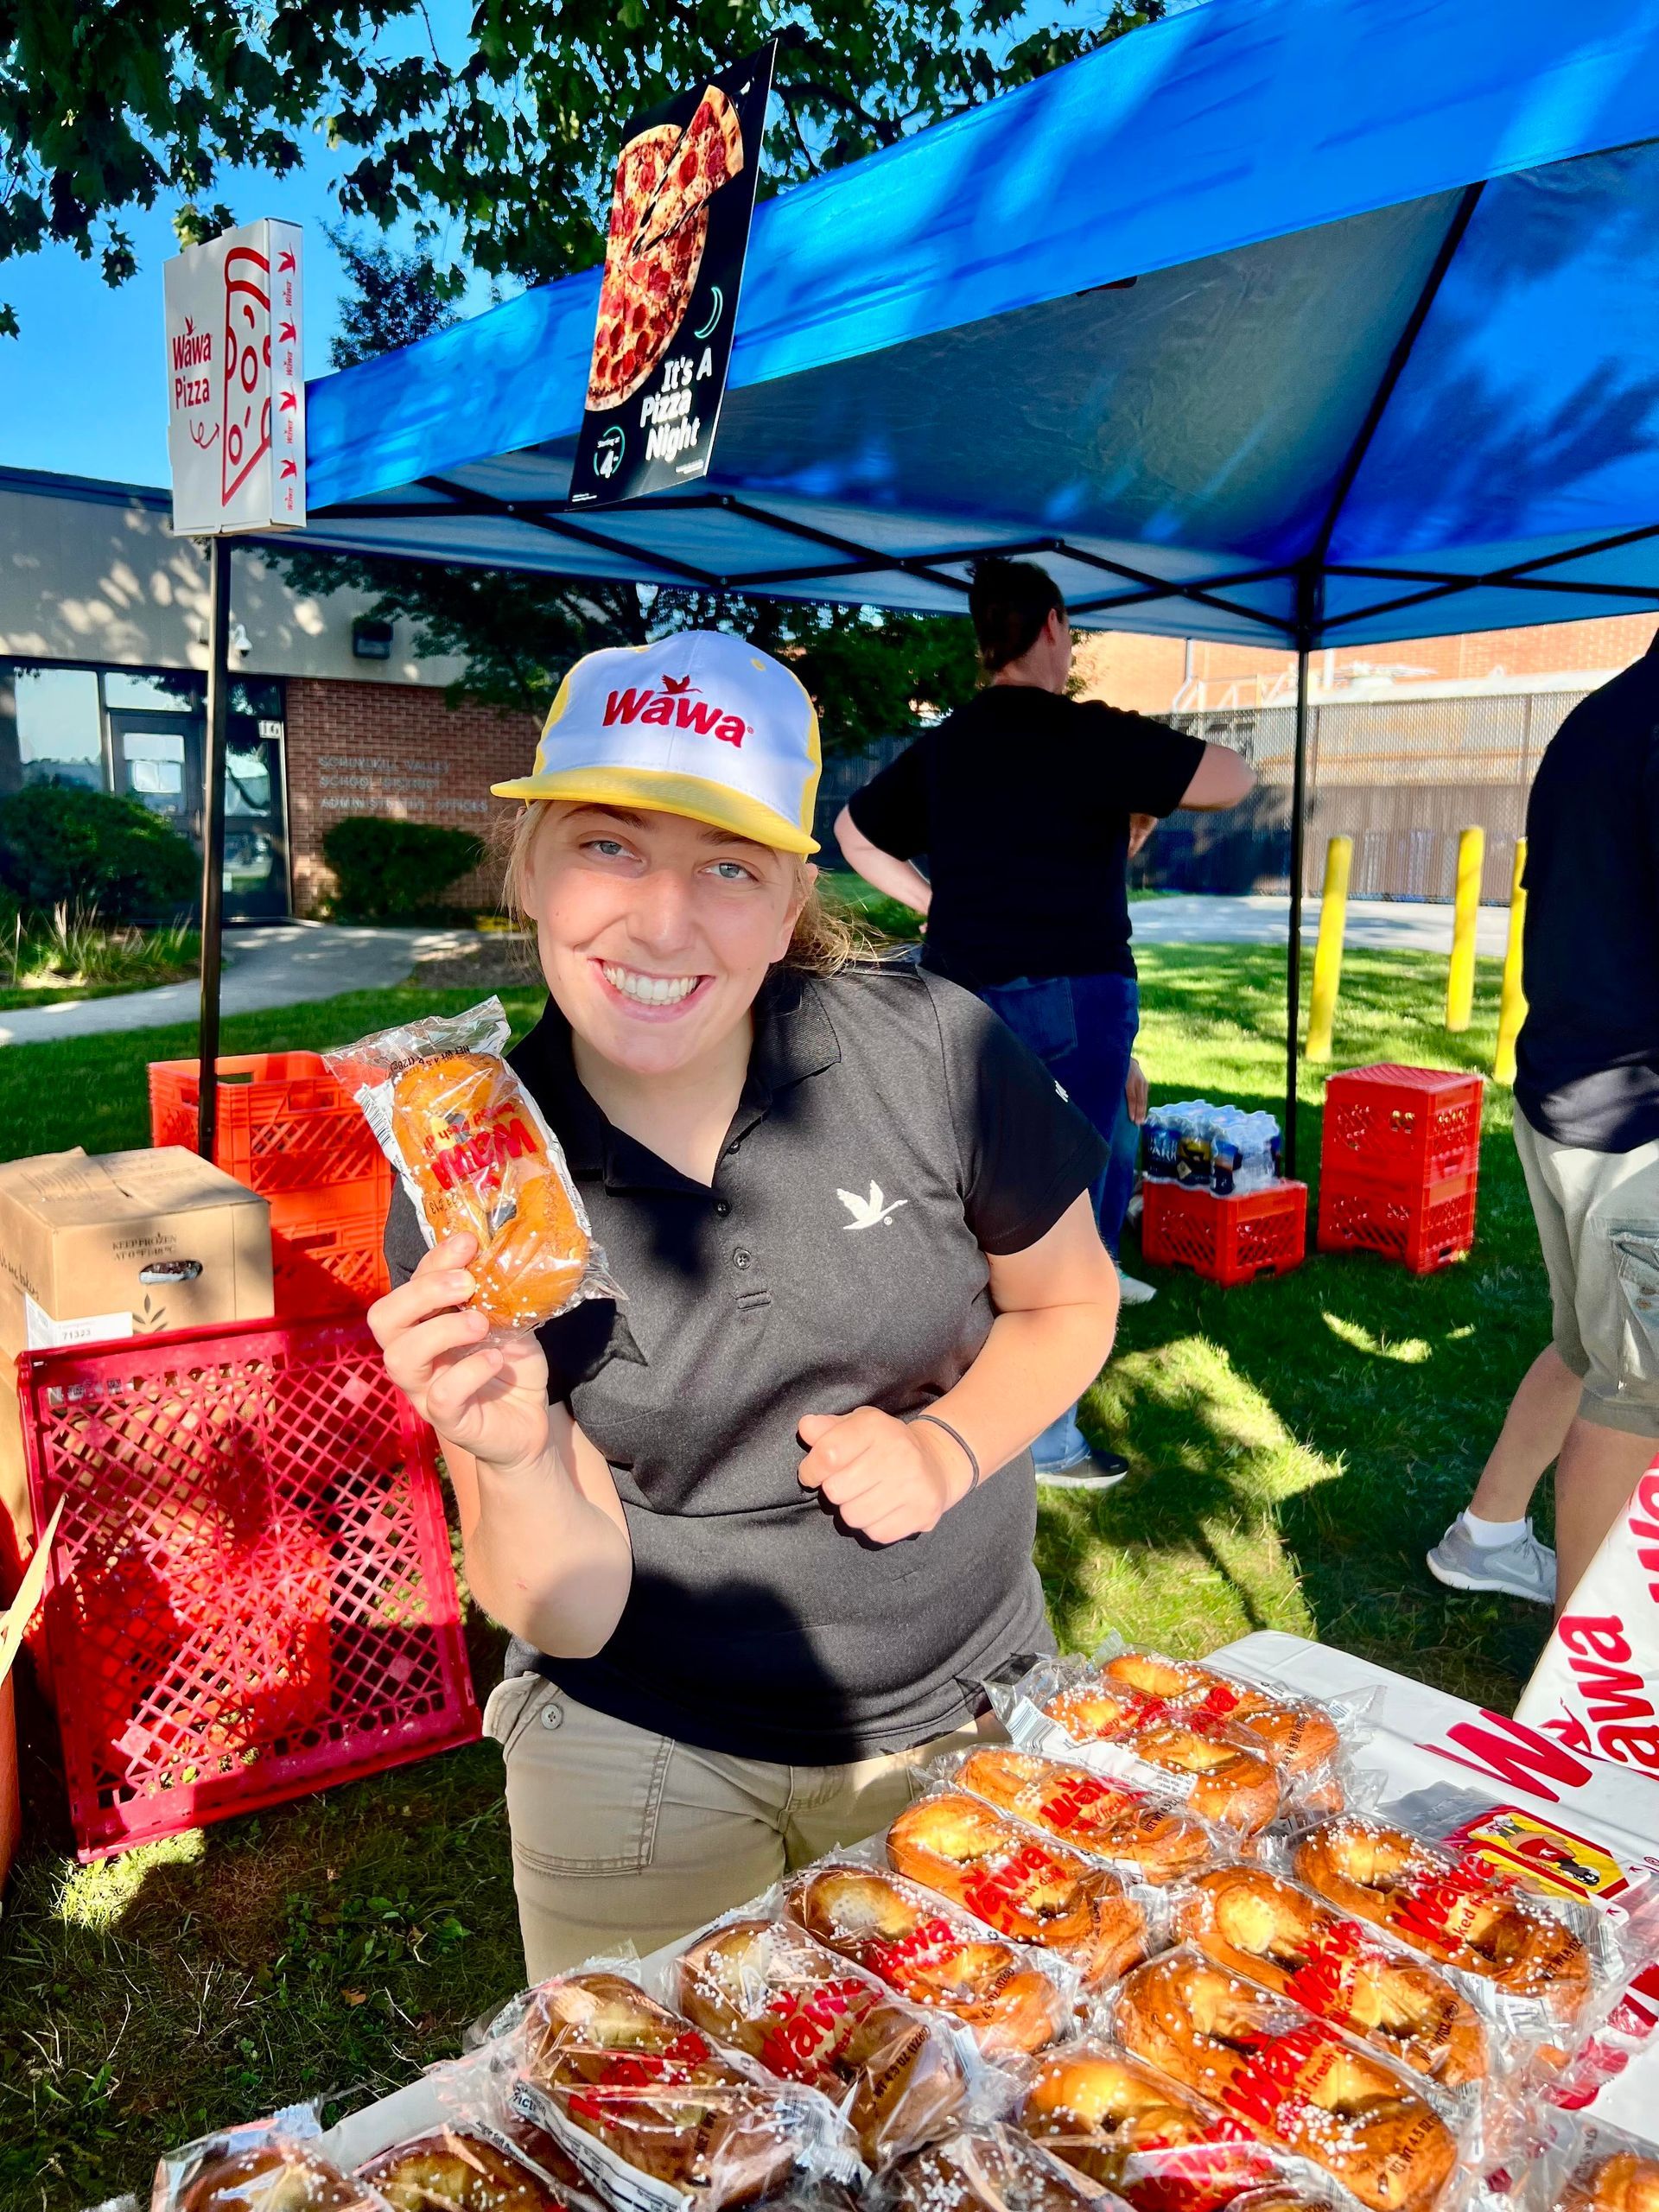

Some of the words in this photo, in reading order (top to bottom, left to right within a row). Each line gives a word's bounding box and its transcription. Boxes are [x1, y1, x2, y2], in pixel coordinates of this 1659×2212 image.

[284, 279, 294, 307] Wawa
[173, 331, 213, 372] Wawa
[285, 350, 294, 377] Wawa
[661, 355, 694, 393] It's
[696, 346, 712, 381] A
[175, 376, 211, 410] Pizza
[639, 388, 692, 428] Pizza
[645, 416, 701, 463] Night
[261, 722, 280, 737] 16
[602, 688, 750, 748] Wawa
[432, 1117, 537, 1191] Wawa
[1390, 1854, 1498, 1942] Wawa
[763, 1978, 868, 2081] Wawa
[1221, 2020, 1344, 2126] Wawa
[1306, 2051, 1341, 2090] fresh
